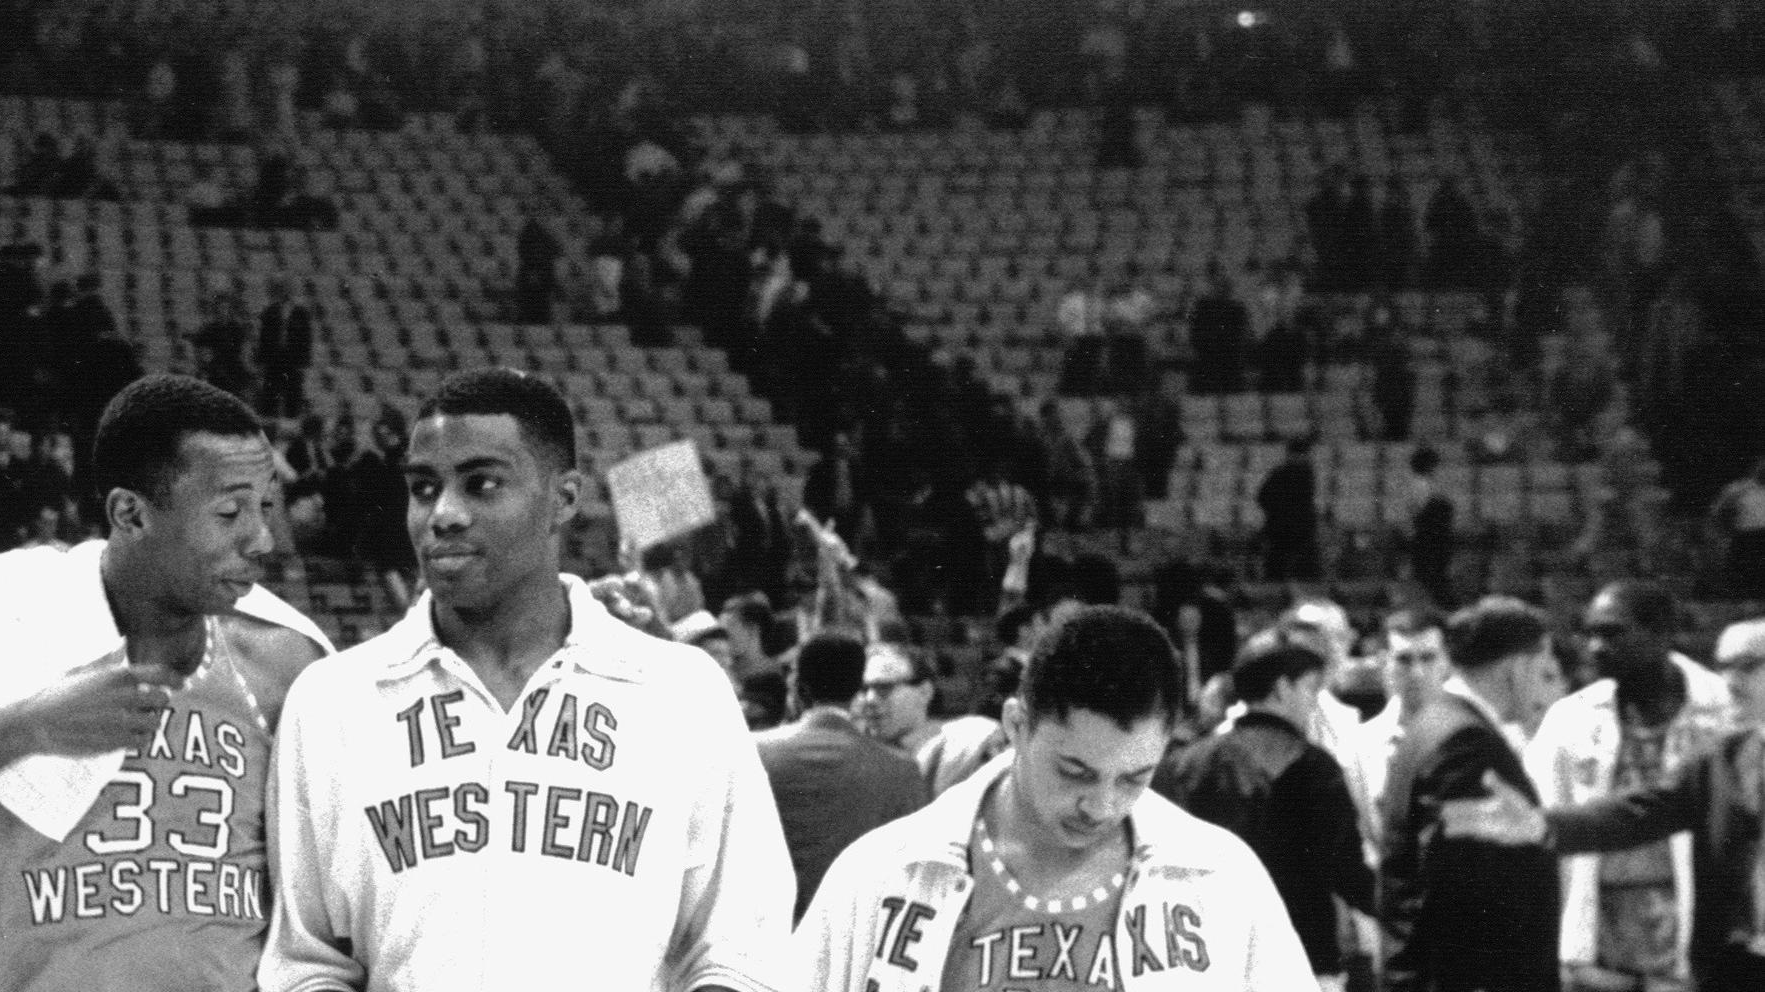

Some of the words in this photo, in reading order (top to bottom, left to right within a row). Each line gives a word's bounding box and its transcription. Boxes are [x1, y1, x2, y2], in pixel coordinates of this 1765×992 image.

[124, 706, 246, 779] XAS
[85, 769, 234, 860] 33
[364, 780, 653, 878] WESTERN
[22, 858, 265, 925] WESTERN
[970, 921, 1118, 992] TEXA
